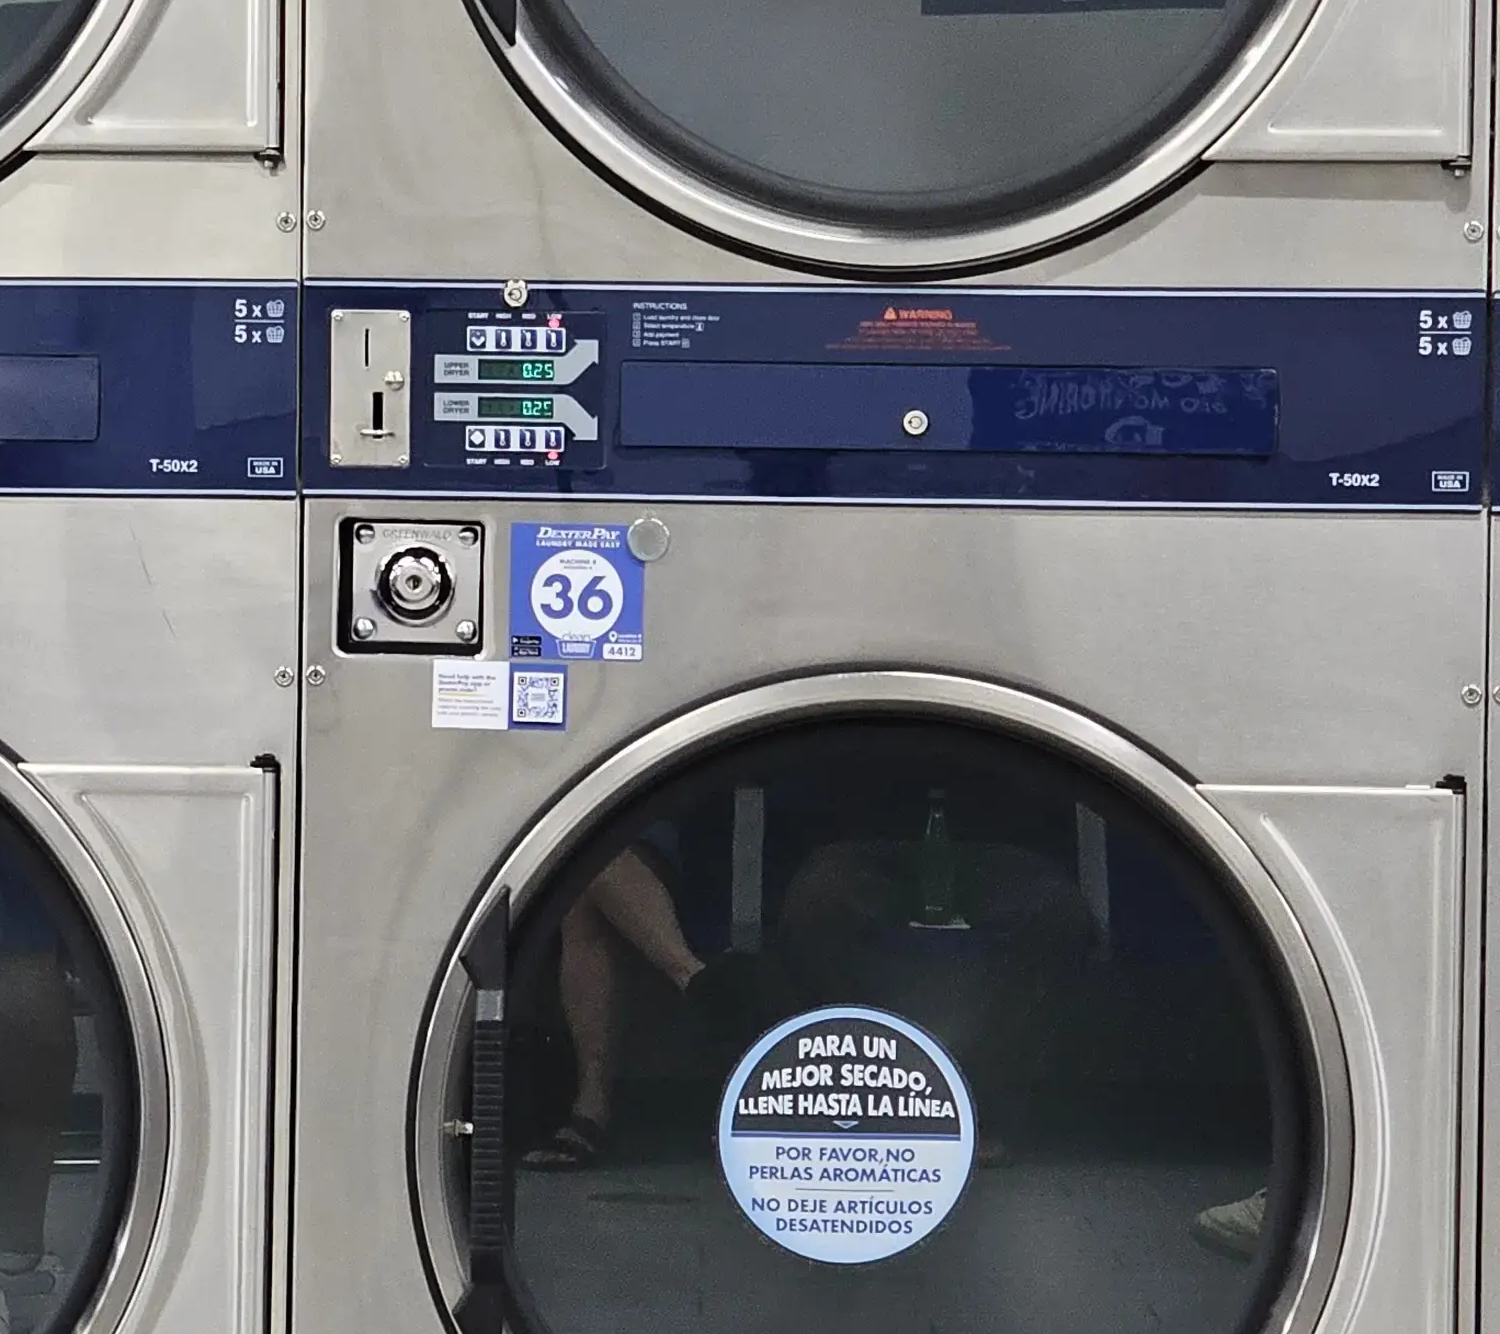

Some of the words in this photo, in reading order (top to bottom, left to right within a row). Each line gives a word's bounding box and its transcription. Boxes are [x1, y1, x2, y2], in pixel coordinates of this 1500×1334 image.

[234, 299, 248, 318] 5
[252, 304, 262, 318] x
[1419, 310, 1433, 329] 5
[1437, 315, 1449, 329] x
[234, 324, 248, 343] 5
[251, 330, 262, 343] x
[1418, 336, 1433, 356] 5
[1437, 342, 1449, 356] x
[149, 459, 199, 473] T-50X2
[255, 466, 276, 474] USA
[1328, 472, 1380, 487] T-50X2
[539, 573, 614, 621] 36
[607, 647, 637, 657] 4412
[798, 1034, 857, 1060] PARA
[862, 1035, 897, 1061] UN
[761, 1063, 834, 1091] MEJOR
[840, 1064, 933, 1096] SECADO,
[738, 1094, 794, 1116] LLENE
[797, 1093, 863, 1117] HASTA
[867, 1093, 894, 1118] LA
[897, 1091, 956, 1119] LÍNEA
[775, 1146, 812, 1161] POR
[886, 1148, 916, 1163] NO
[748, 1166, 813, 1181] PERLAS
[819, 1164, 941, 1184] AROMÁTICAS
[751, 1197, 781, 1213] NO
[787, 1198, 828, 1214] DEJE
[833, 1195, 934, 1215] ARTÍCULOS
[775, 1217, 913, 1235] DESATENDIDOS
